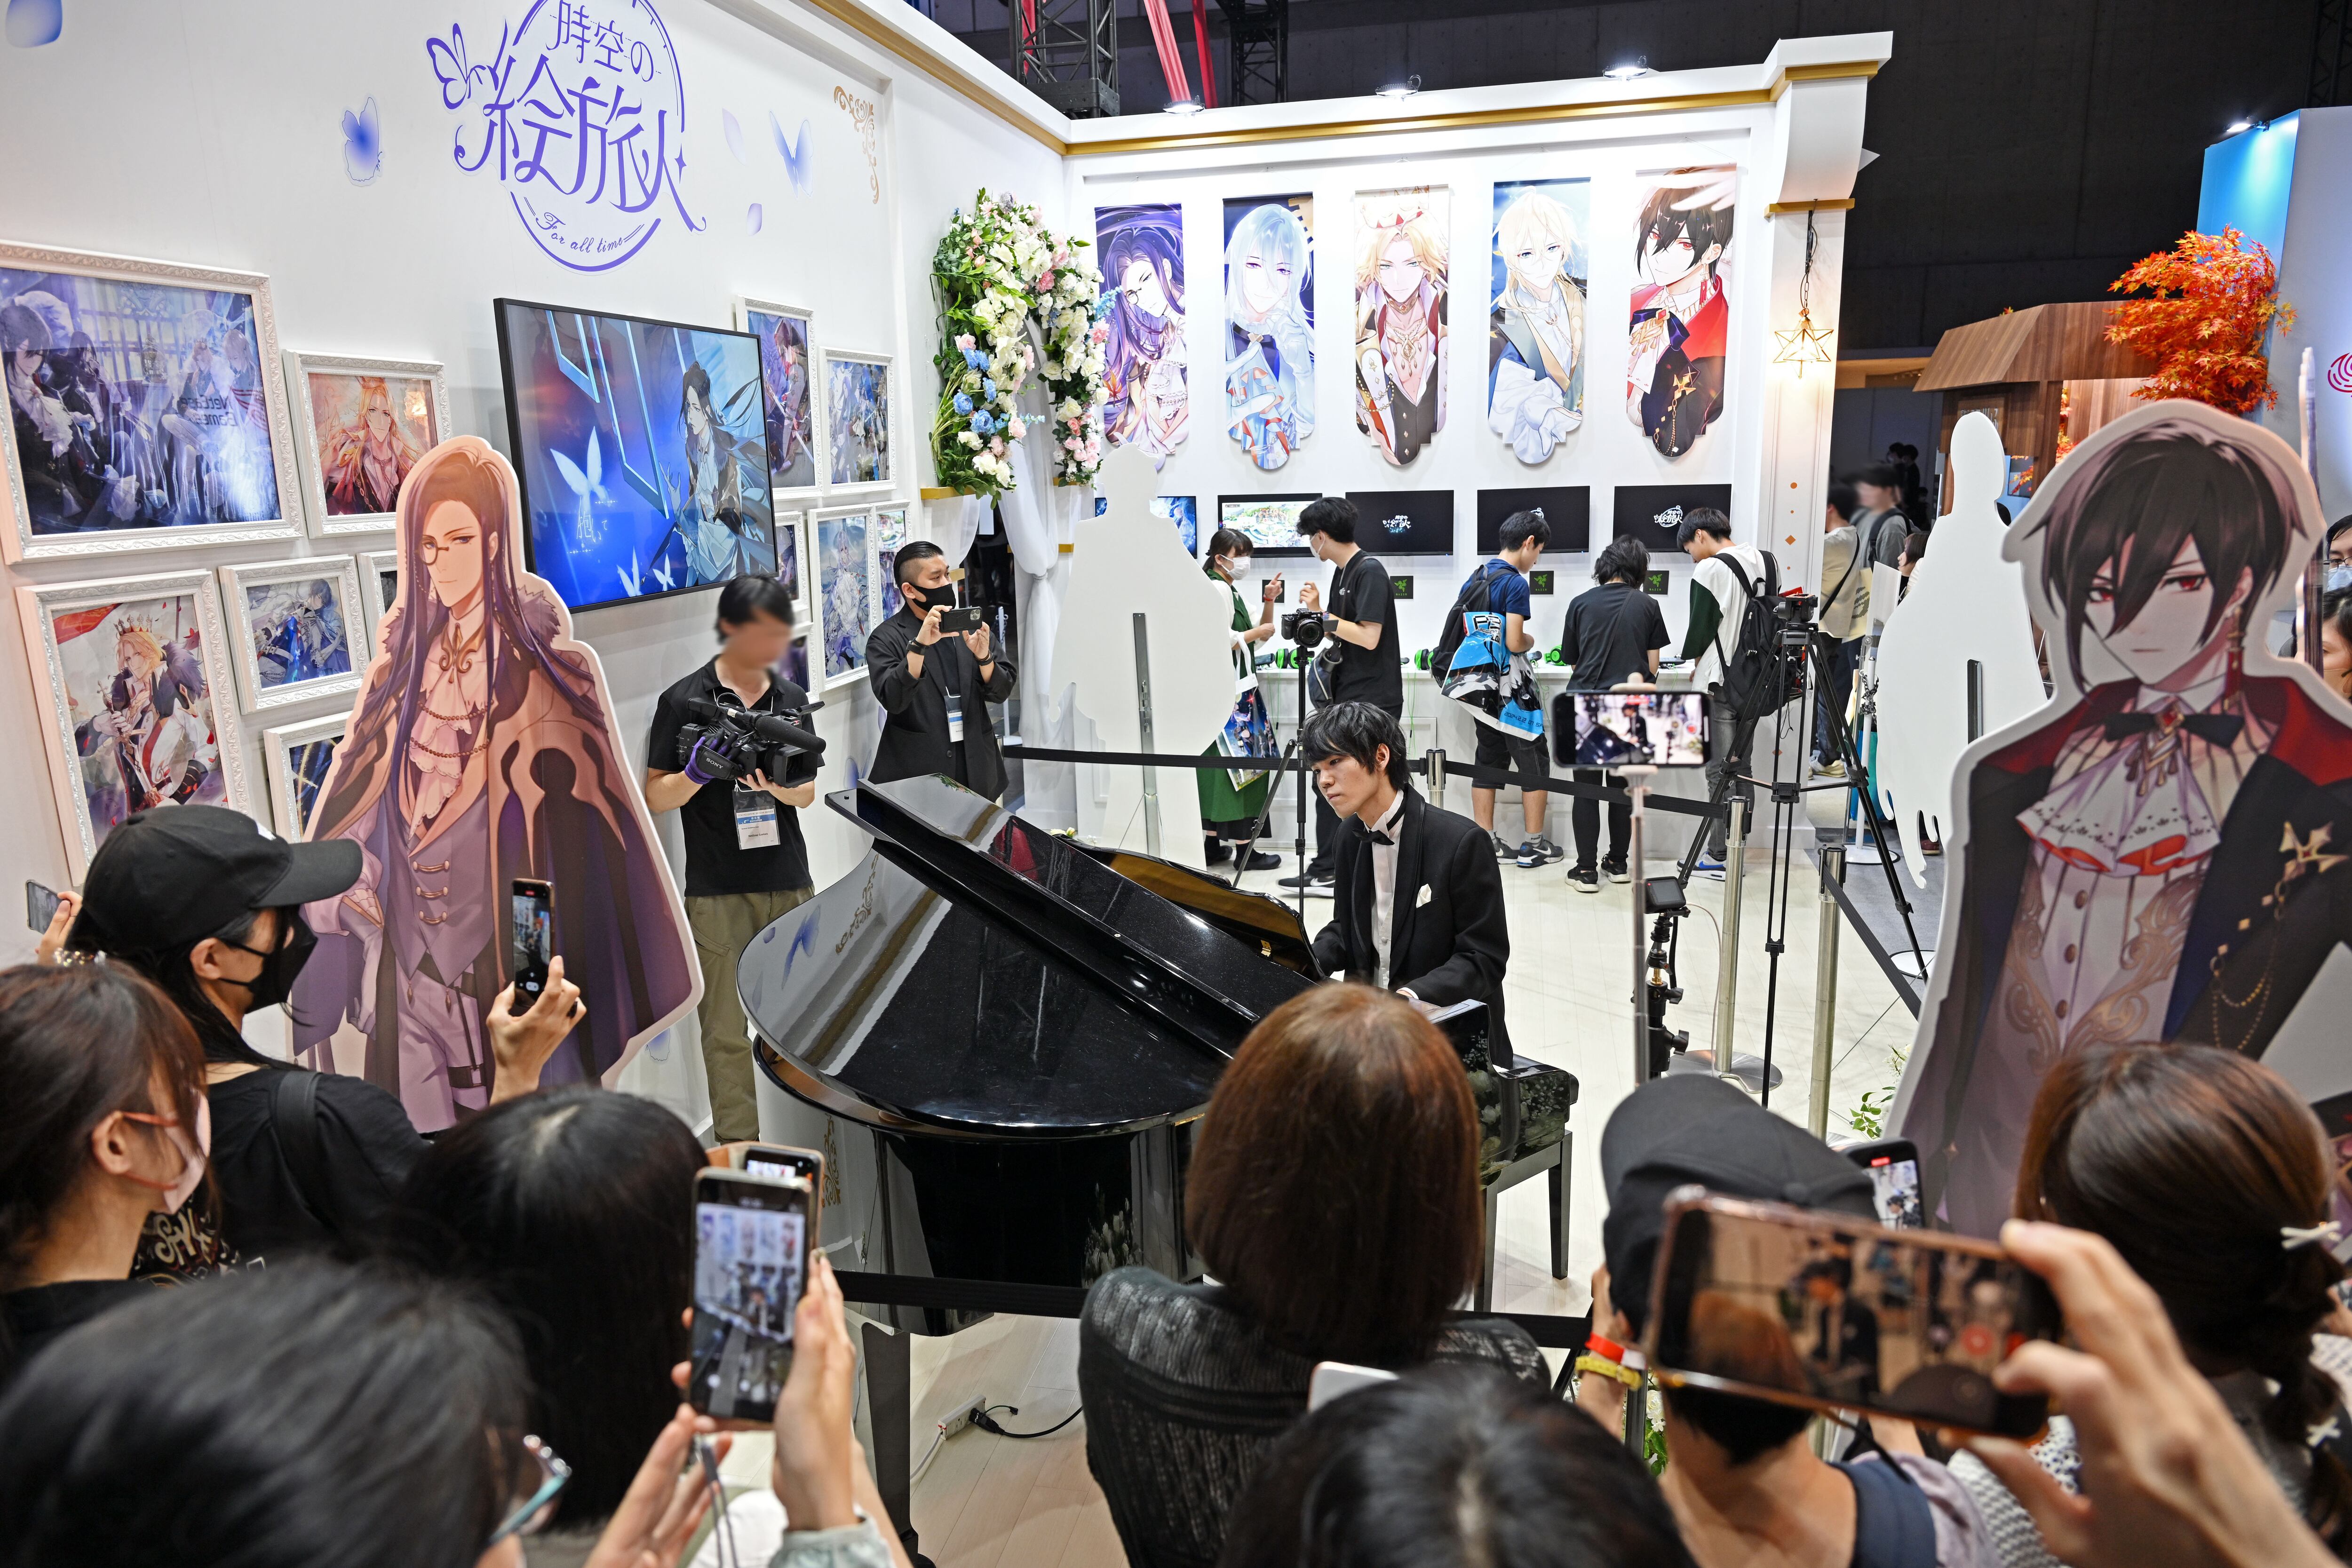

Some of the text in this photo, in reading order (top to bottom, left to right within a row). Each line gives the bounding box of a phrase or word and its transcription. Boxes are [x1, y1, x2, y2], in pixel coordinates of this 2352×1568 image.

[545, 0, 654, 82] 時空の
[535, 212, 623, 253] For all time
[706, 757, 723, 770] SONY
